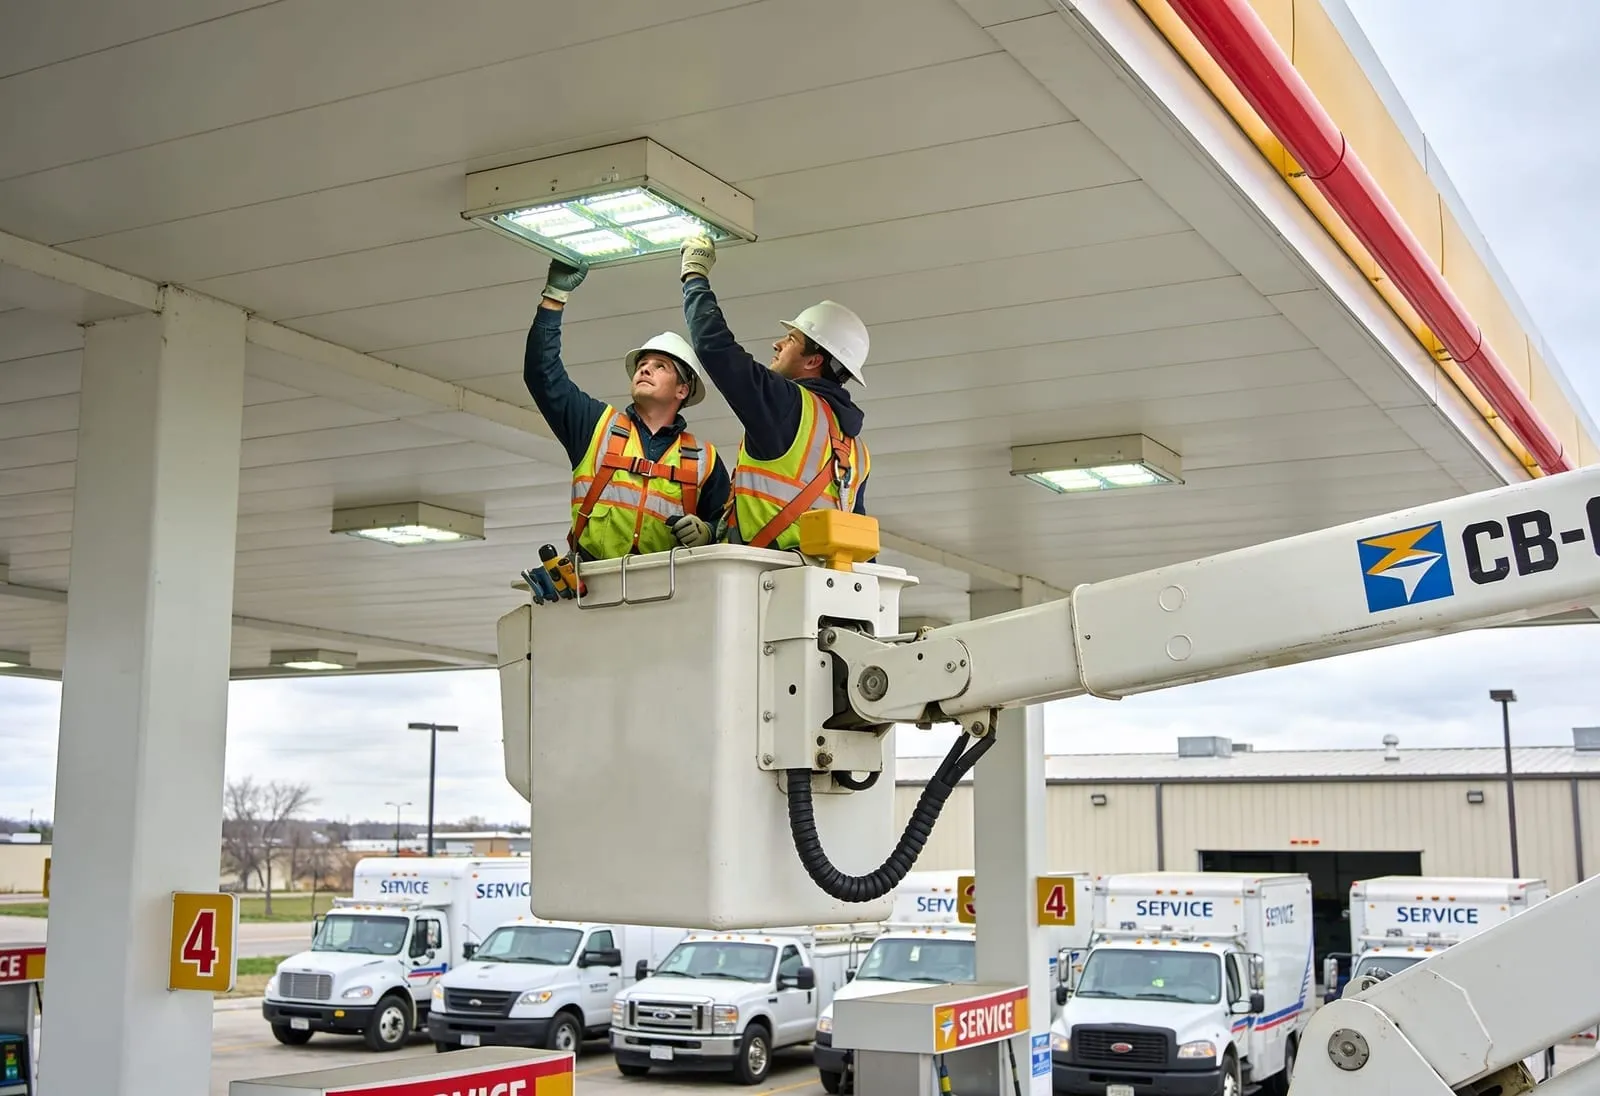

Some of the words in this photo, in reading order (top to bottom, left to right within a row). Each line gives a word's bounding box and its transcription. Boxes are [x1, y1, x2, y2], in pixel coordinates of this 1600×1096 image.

[476, 882, 532, 899] SERVIC
[1044, 884, 1068, 920] 4
[1397, 906, 1478, 924] SERVICE
[181, 909, 219, 977] 4
[958, 1001, 1014, 1041] SERVICE
